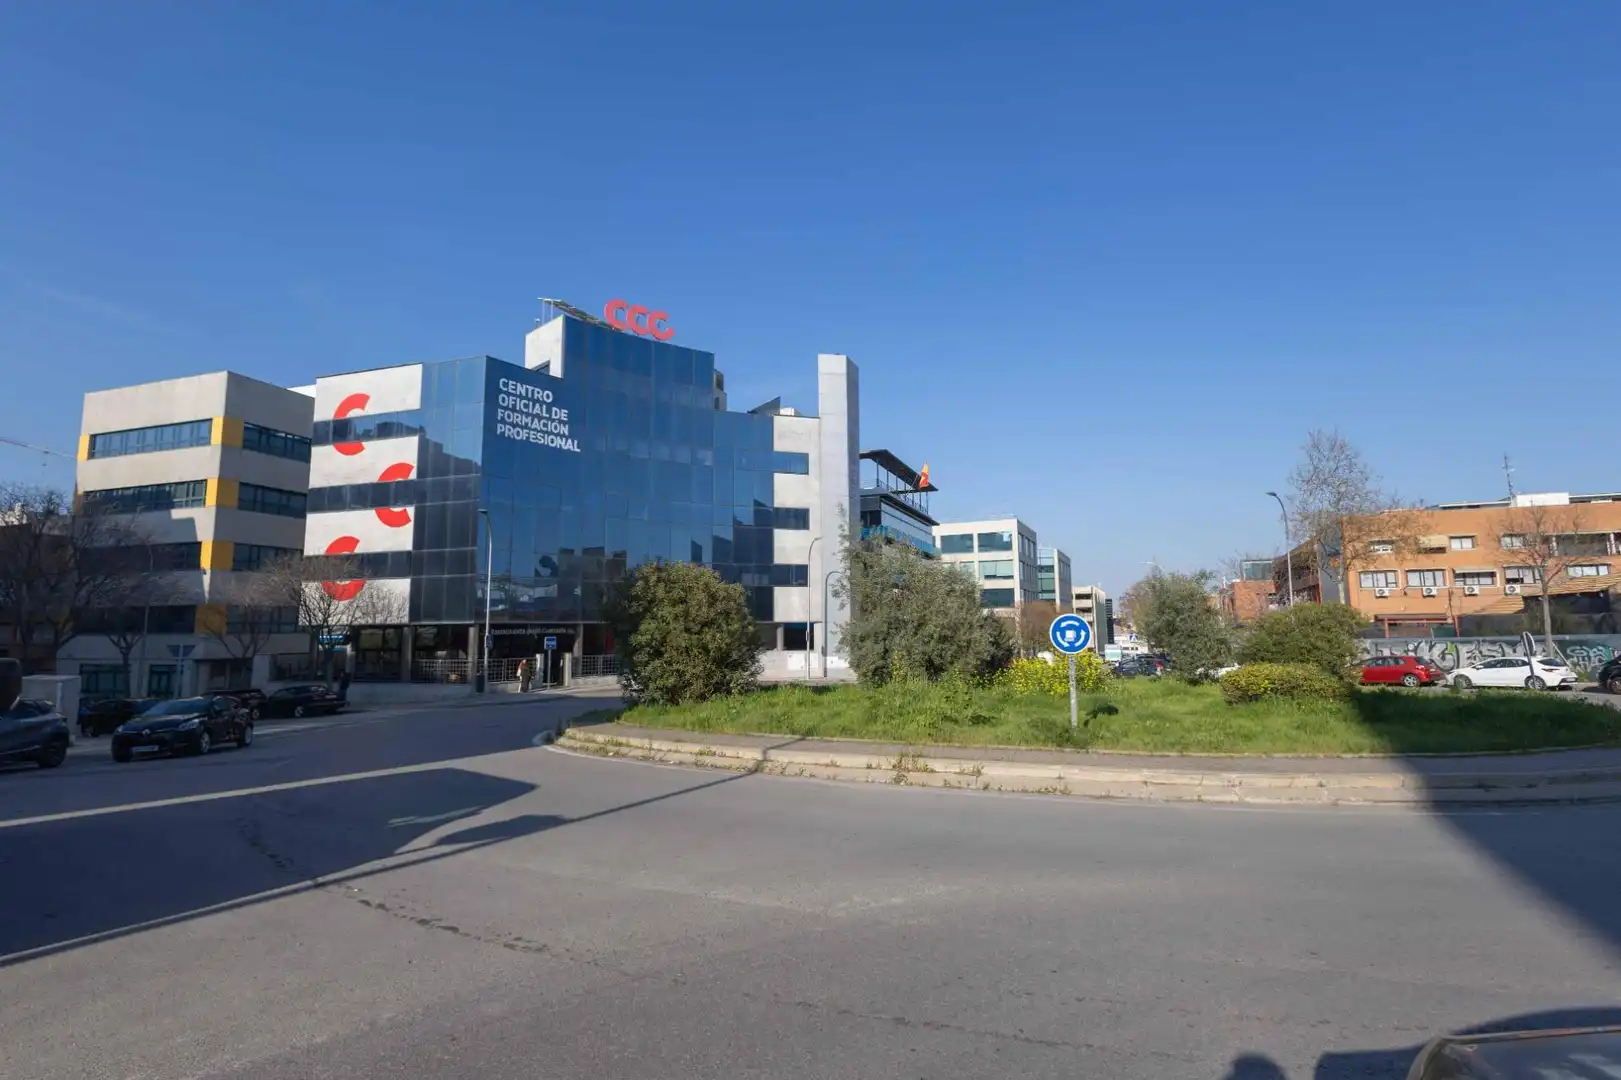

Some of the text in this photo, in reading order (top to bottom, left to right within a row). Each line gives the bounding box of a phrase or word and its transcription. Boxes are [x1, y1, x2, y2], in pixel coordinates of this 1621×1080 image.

[604, 298, 674, 341] CCC
[499, 378, 553, 404] CENTRO
[499, 394, 569, 421] OFICIAL DE
[497, 408, 569, 436] FORMACIÓN
[496, 424, 580, 452] PROFESIONAL
